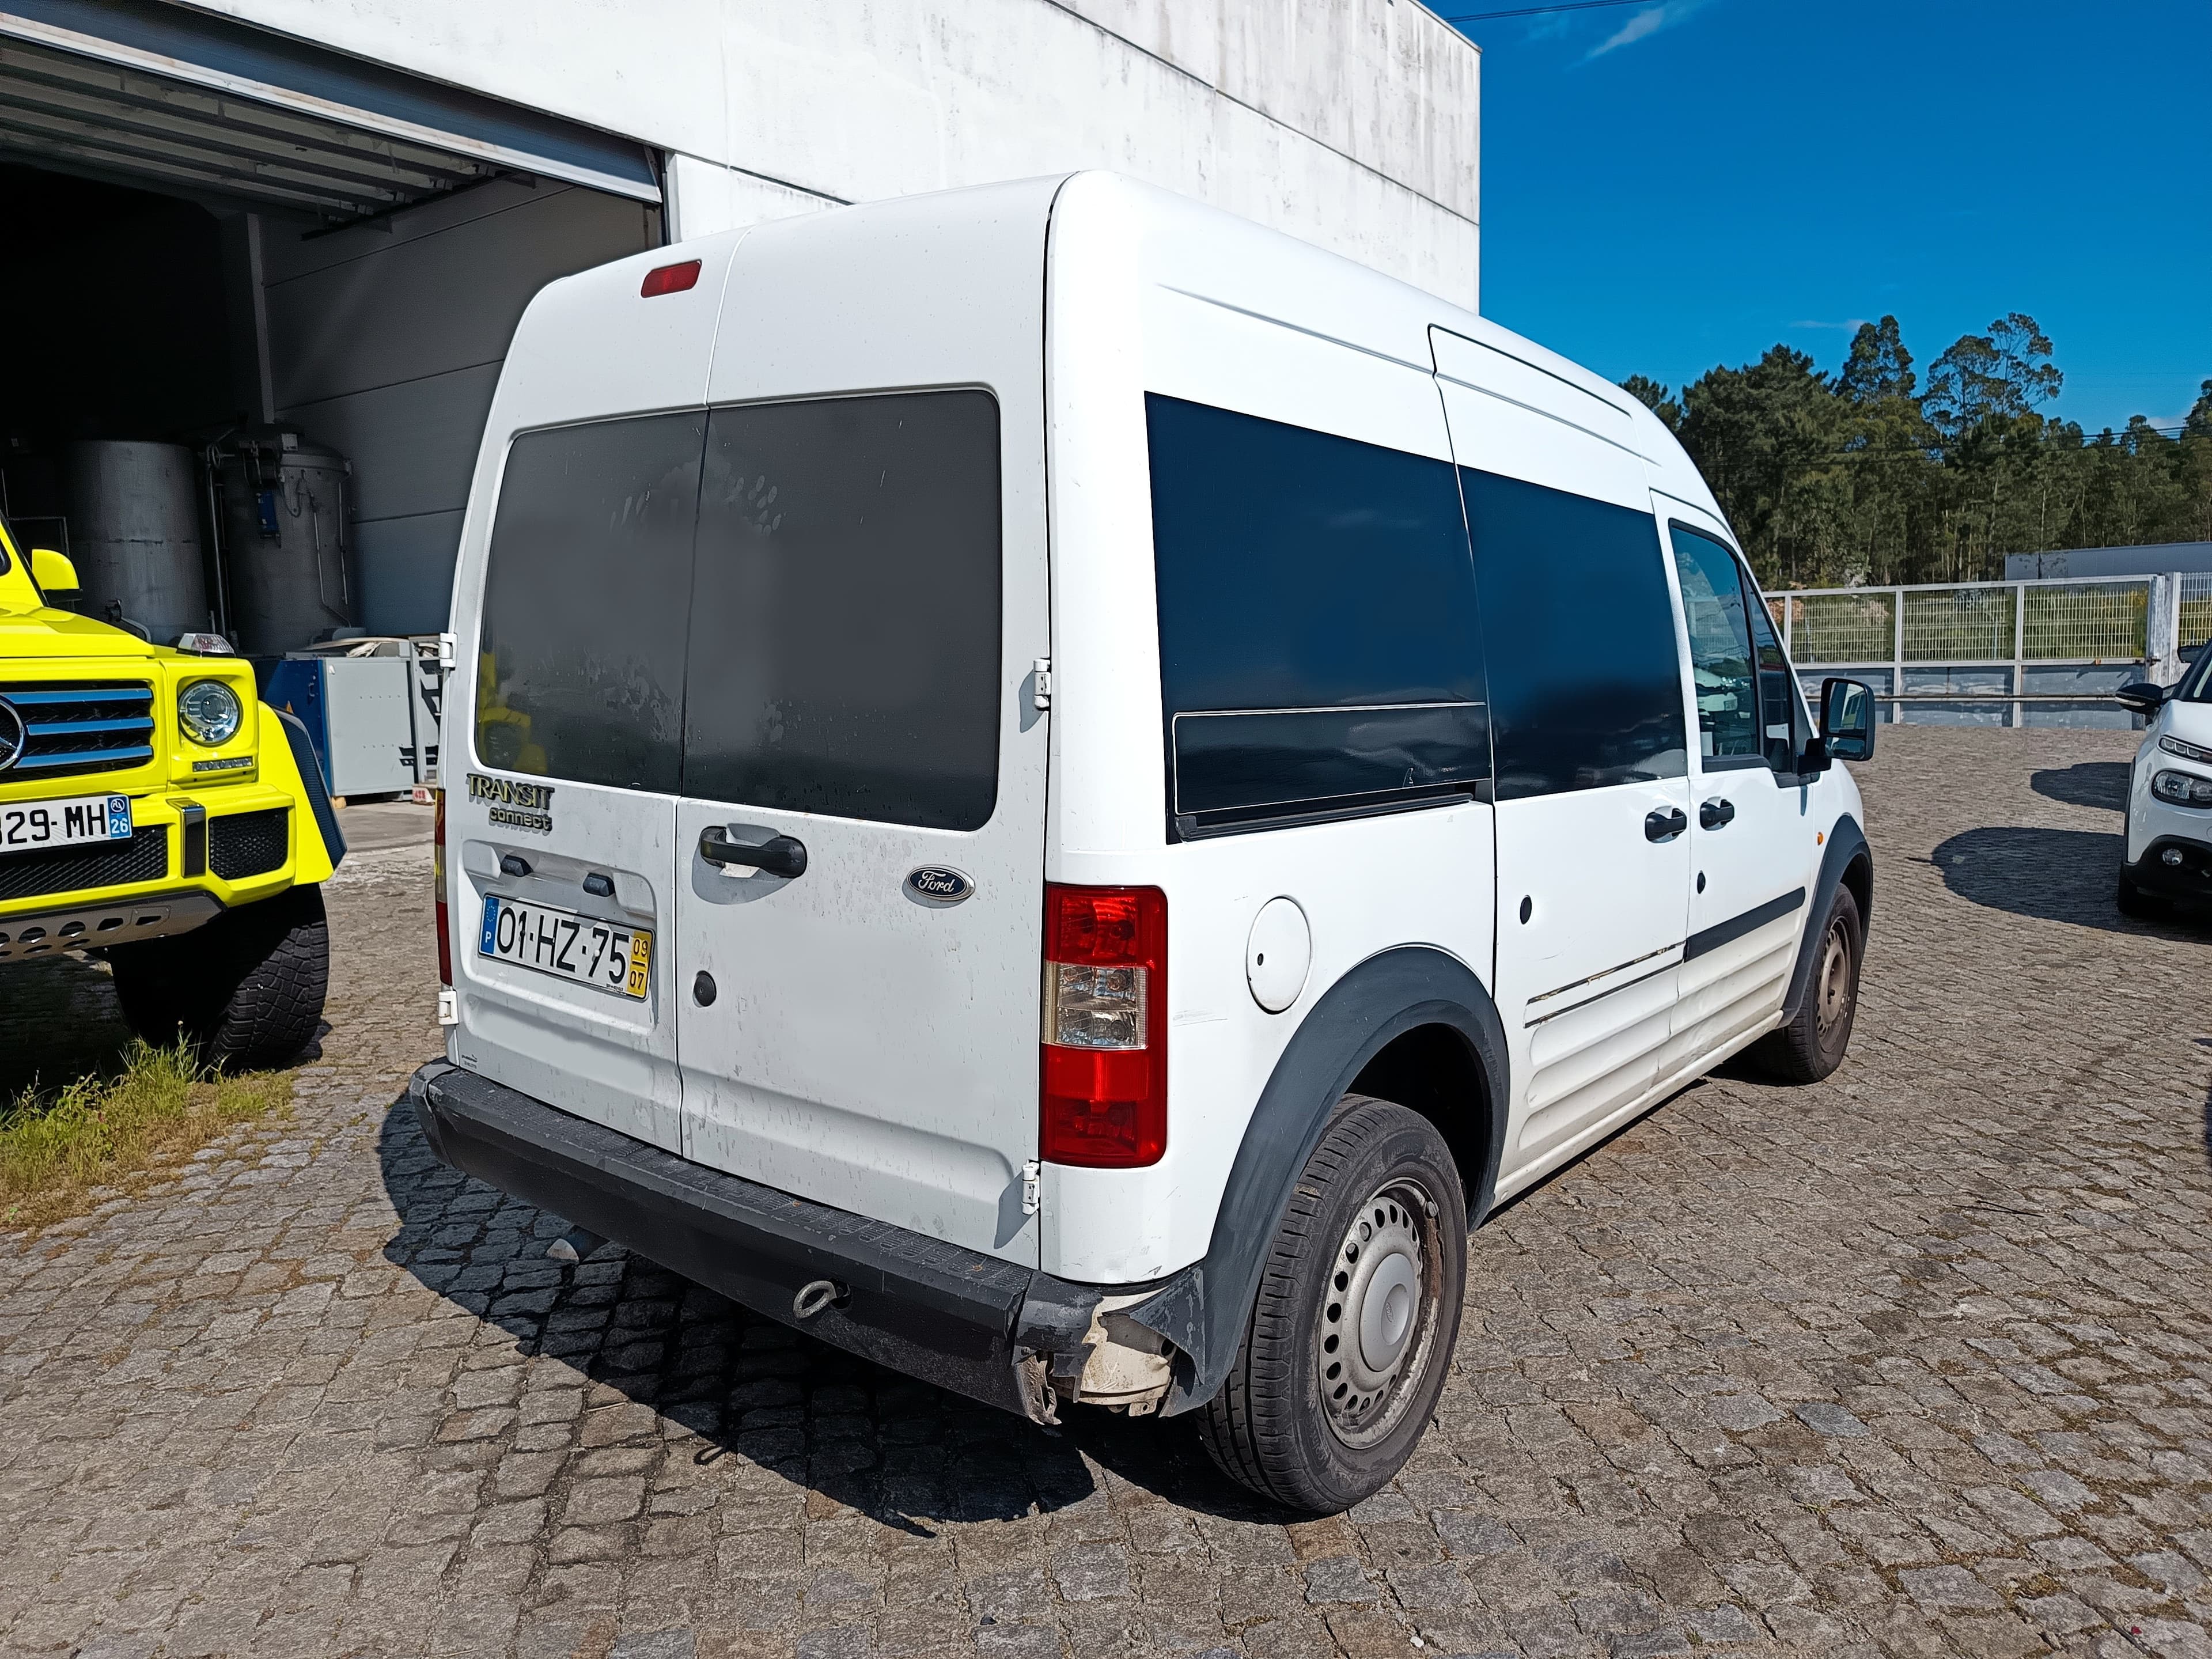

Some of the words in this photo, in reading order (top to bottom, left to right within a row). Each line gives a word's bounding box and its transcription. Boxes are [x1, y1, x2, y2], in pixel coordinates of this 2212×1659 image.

[467, 773, 555, 810] TRANSIT
[0, 804, 106, 845] 29-MH
[111, 817, 128, 834] 26
[490, 807, 553, 831] connect
[918, 870, 955, 892] Ford
[485, 931, 491, 944] P
[634, 938, 648, 957] 09
[630, 971, 645, 990] 07
